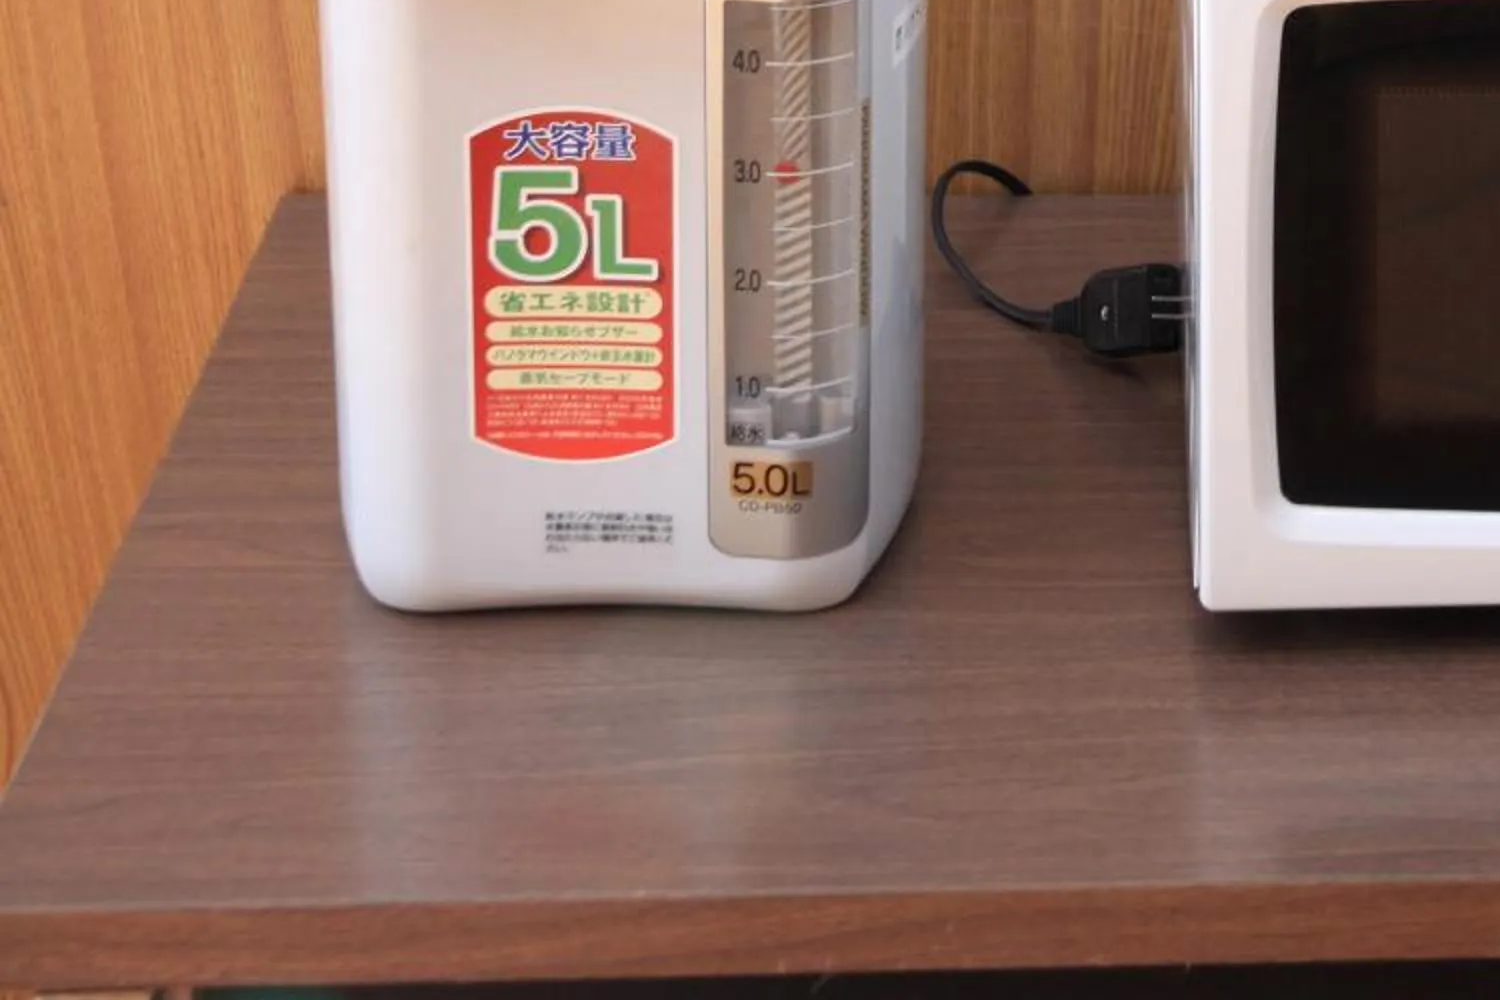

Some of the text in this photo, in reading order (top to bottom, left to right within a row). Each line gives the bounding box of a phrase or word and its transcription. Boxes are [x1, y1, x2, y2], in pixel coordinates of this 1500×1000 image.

[732, 49, 761, 74] 4.0
[503, 120, 636, 161] 大容量
[734, 160, 761, 184] 3.0
[489, 165, 659, 283] 5L
[735, 269, 761, 293] 2.0
[500, 291, 646, 313] 省エネ設計
[735, 376, 761, 398] 1.0
[732, 462, 812, 497] 5.0L
